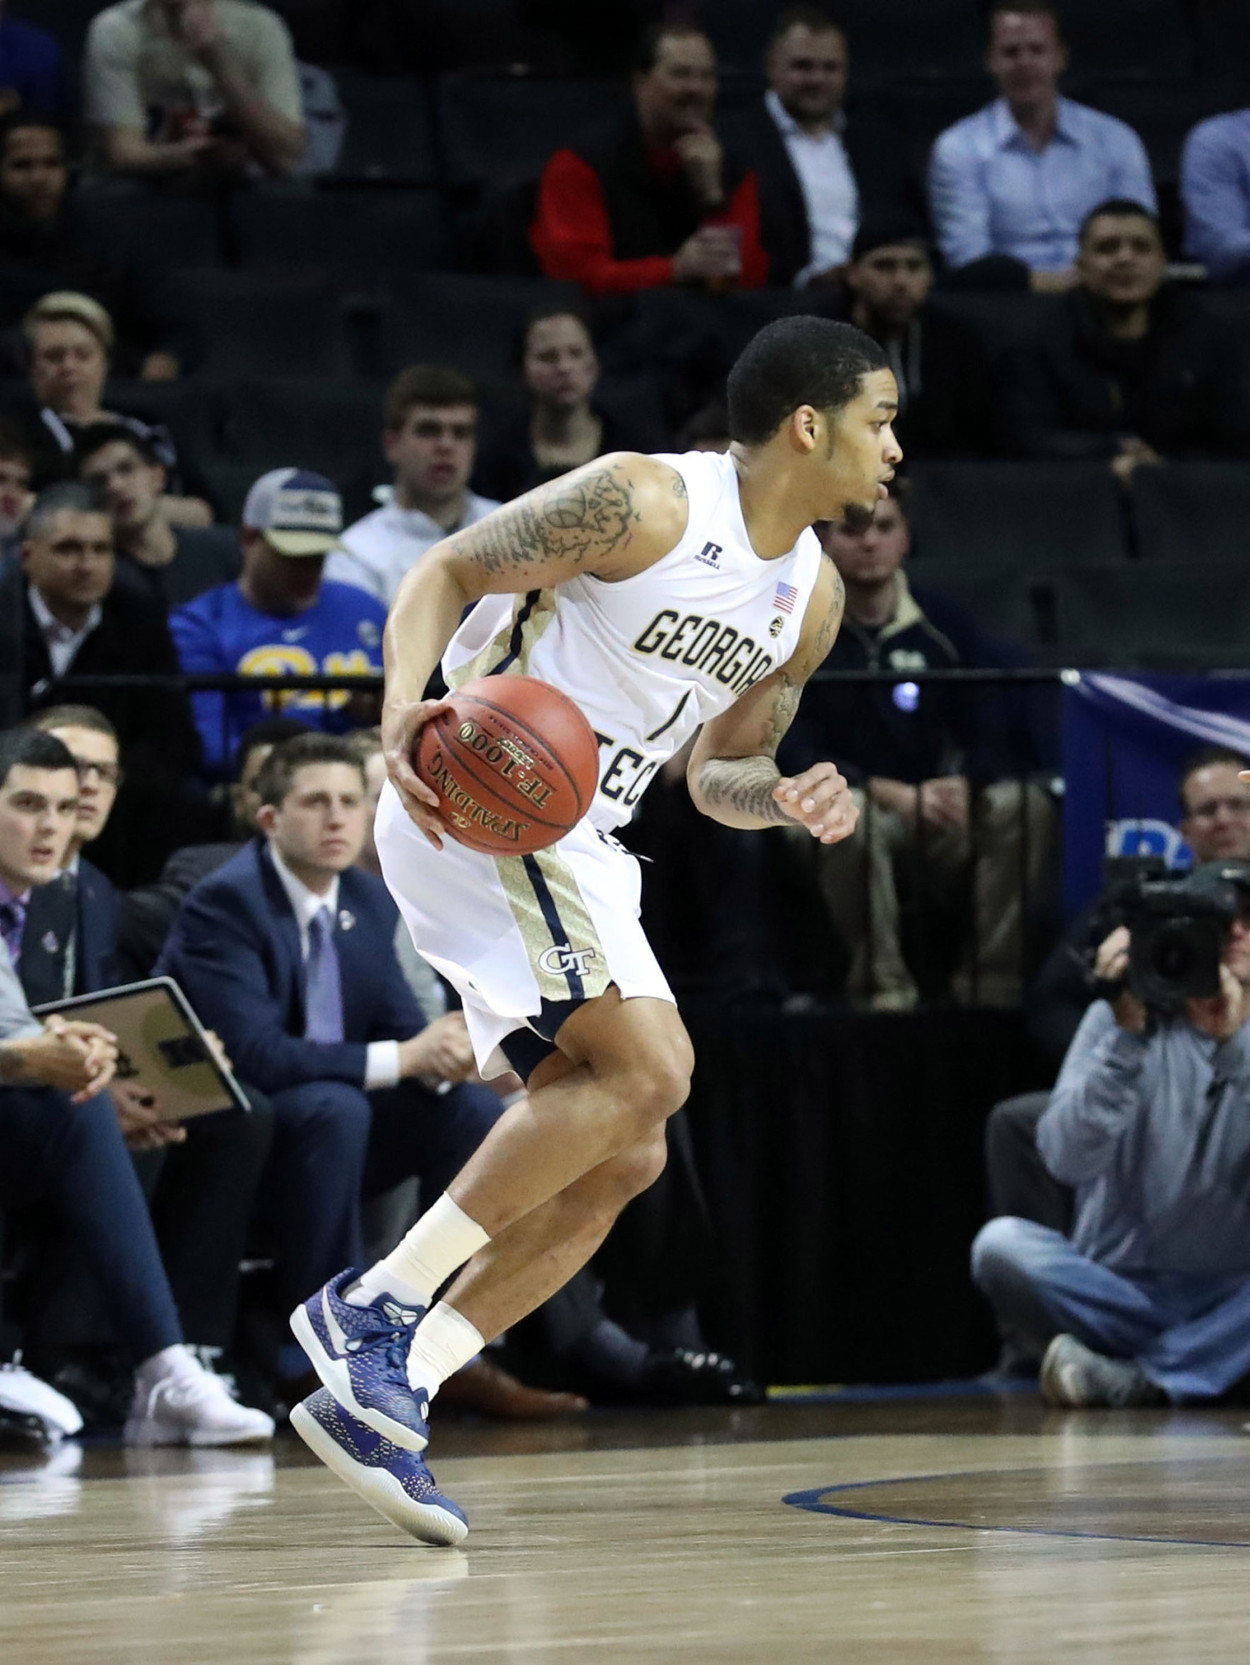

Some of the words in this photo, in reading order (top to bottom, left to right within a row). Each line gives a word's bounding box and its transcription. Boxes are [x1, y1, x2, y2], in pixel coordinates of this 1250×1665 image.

[633, 609, 774, 699] GEORGIA
[426, 752, 532, 842] SPALDING
[458, 721, 554, 810] TF-1000
[538, 942, 596, 976] GT
